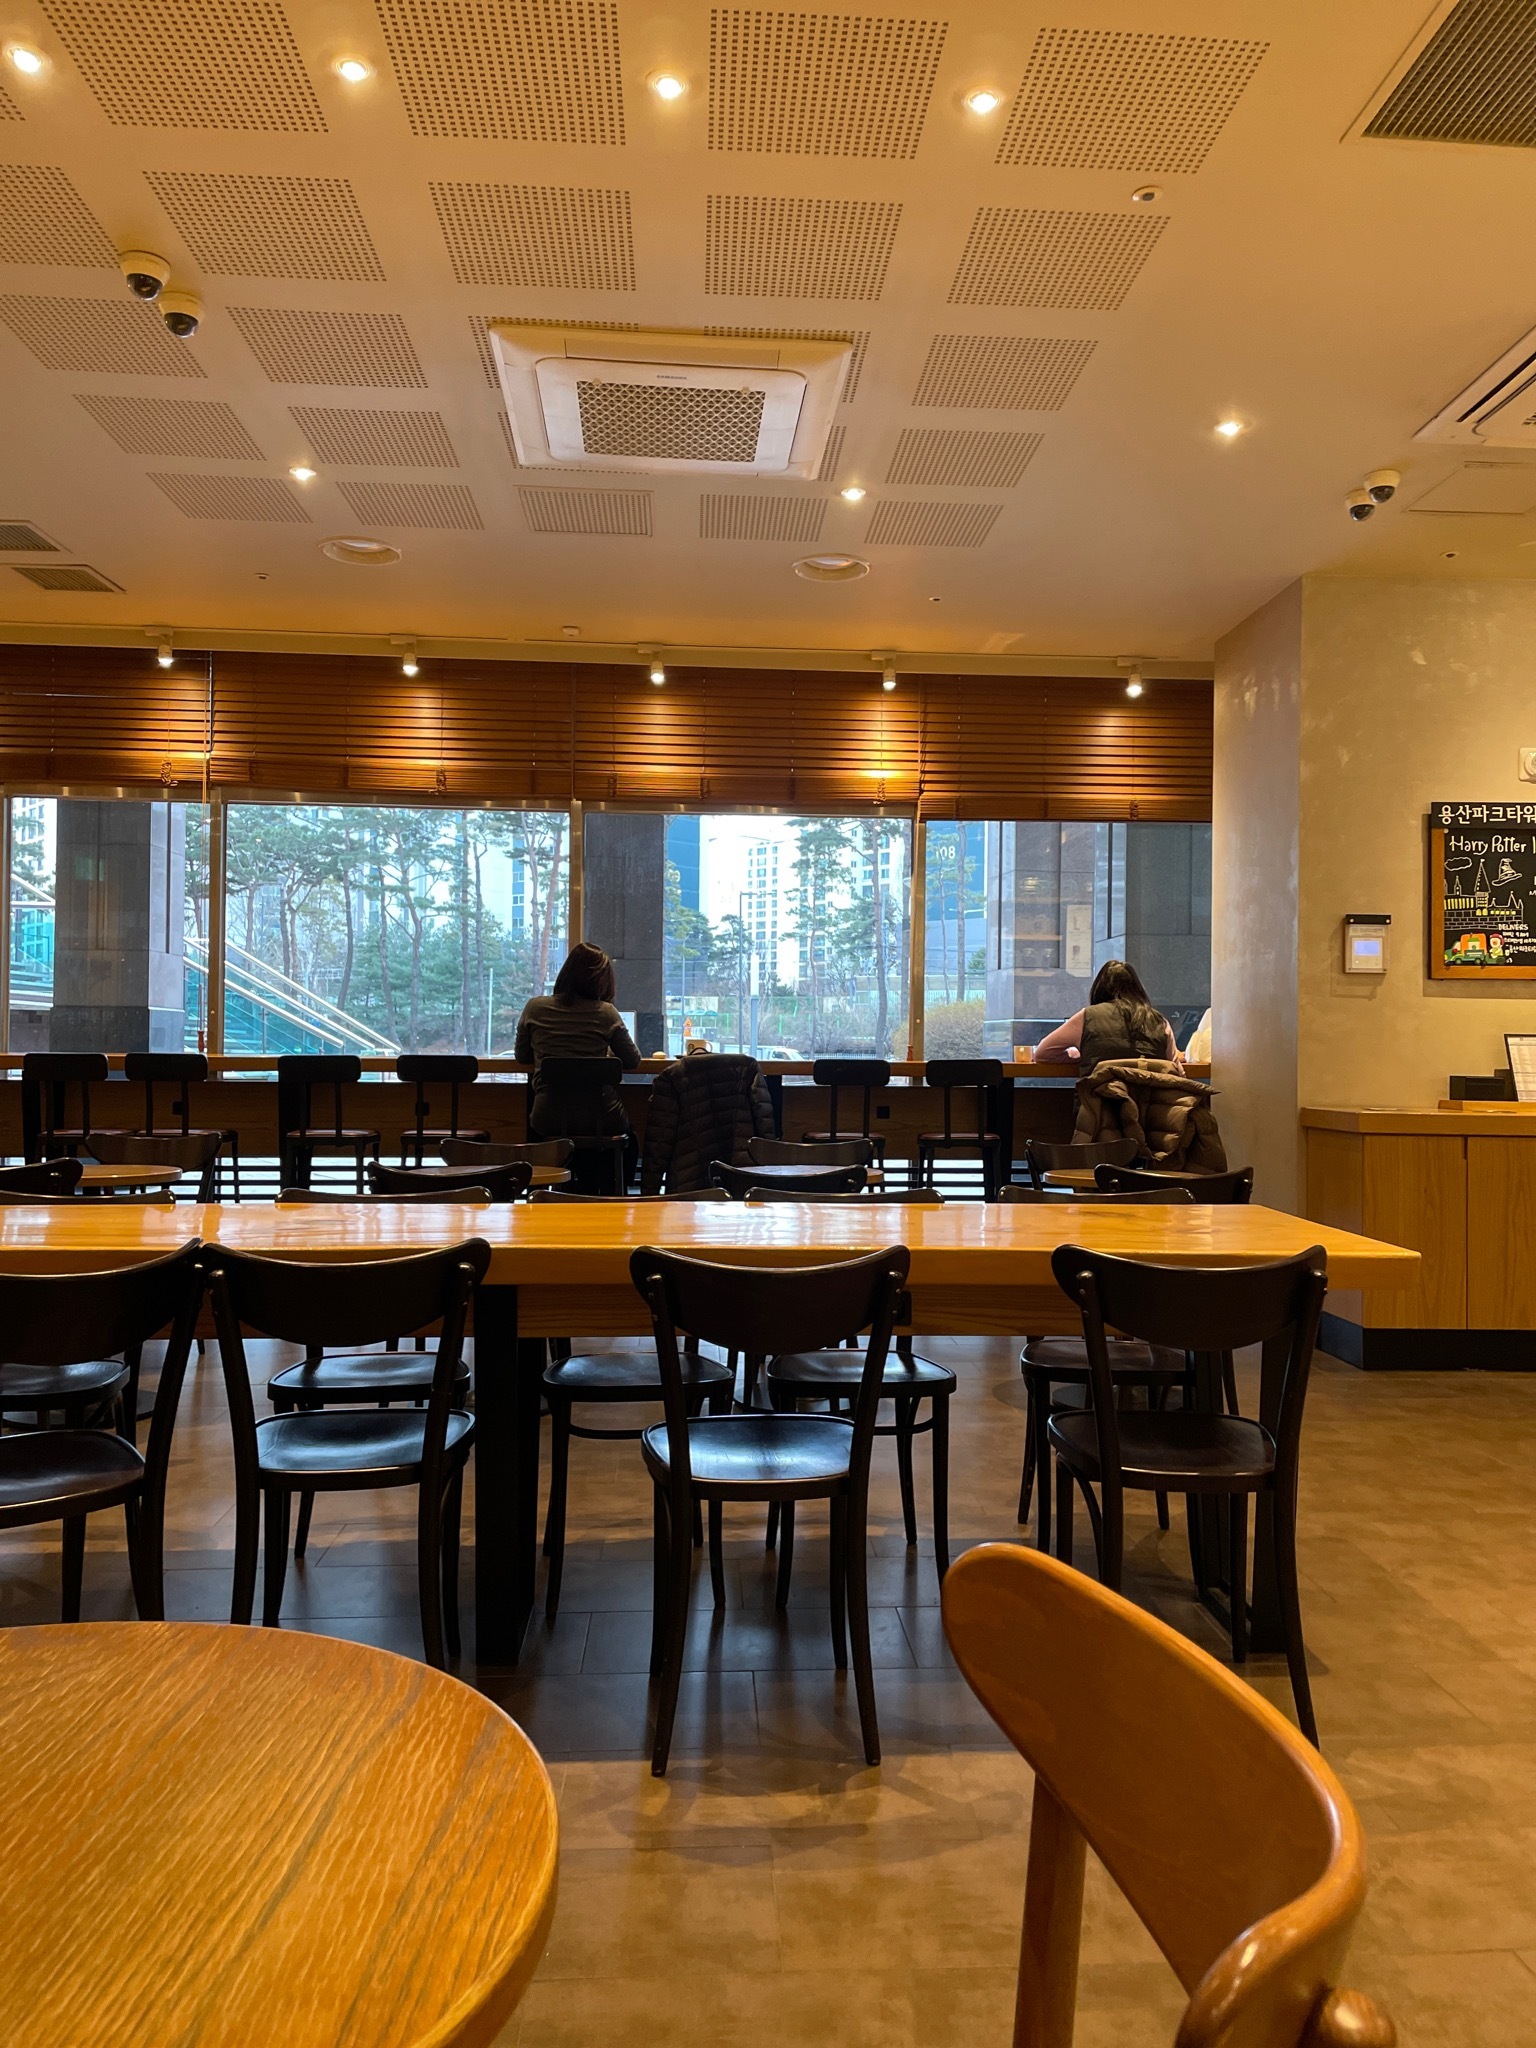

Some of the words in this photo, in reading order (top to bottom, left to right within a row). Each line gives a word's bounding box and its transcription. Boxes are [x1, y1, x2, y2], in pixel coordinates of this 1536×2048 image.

[1438, 804, 1536, 825] 용산파크타워
[1449, 835, 1489, 856] Harry
[1491, 835, 1527, 853] Potter
